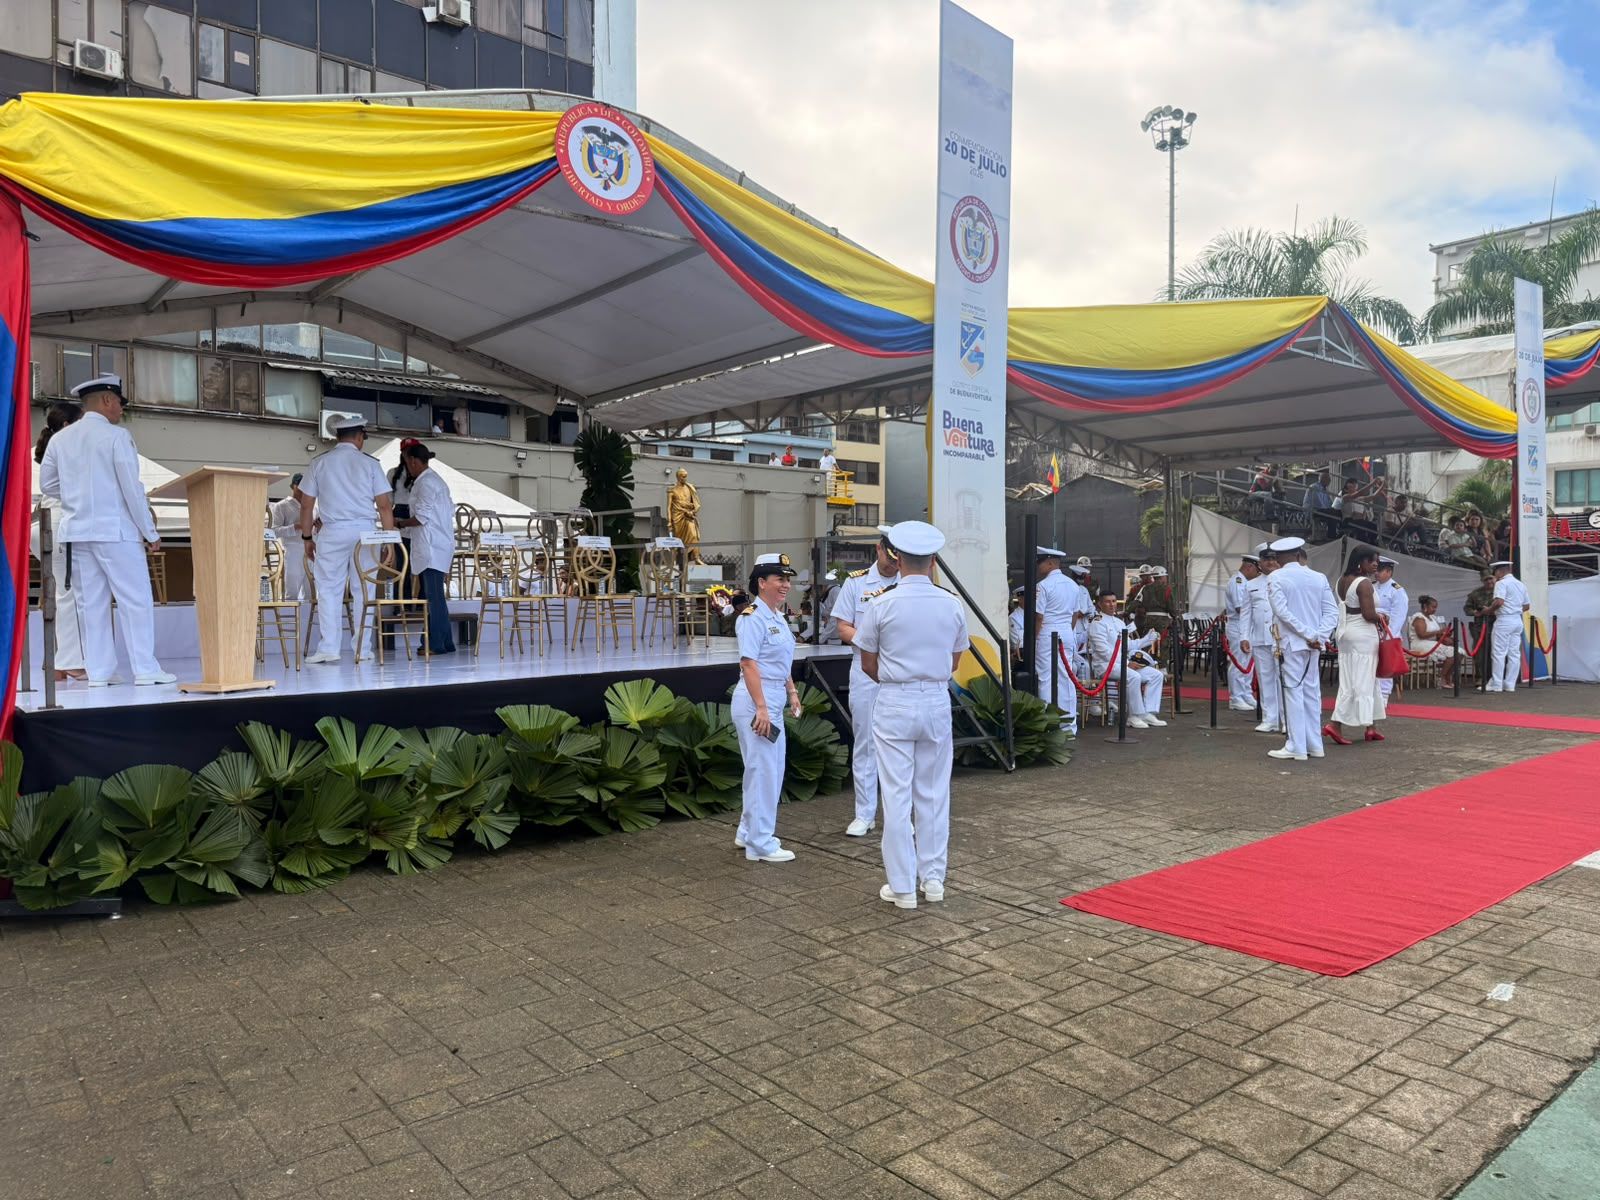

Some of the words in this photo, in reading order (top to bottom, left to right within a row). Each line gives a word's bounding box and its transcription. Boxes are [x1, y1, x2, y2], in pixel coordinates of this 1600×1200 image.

[600, 107, 615, 118] DE
[621, 119, 652, 174] COLOMBIA
[945, 137, 957, 155] 20
[961, 145, 976, 164] DE
[978, 154, 1007, 178] JULIO
[562, 164, 604, 208] LIBERTAD
[606, 202, 613, 211] Y
[616, 192, 646, 211] ORDEN
[949, 387, 956, 395] DE
[957, 389, 992, 402] BUENAVENTURA
[943, 410, 983, 435] Buena
[943, 449, 985, 461] INCOMPARABLE
